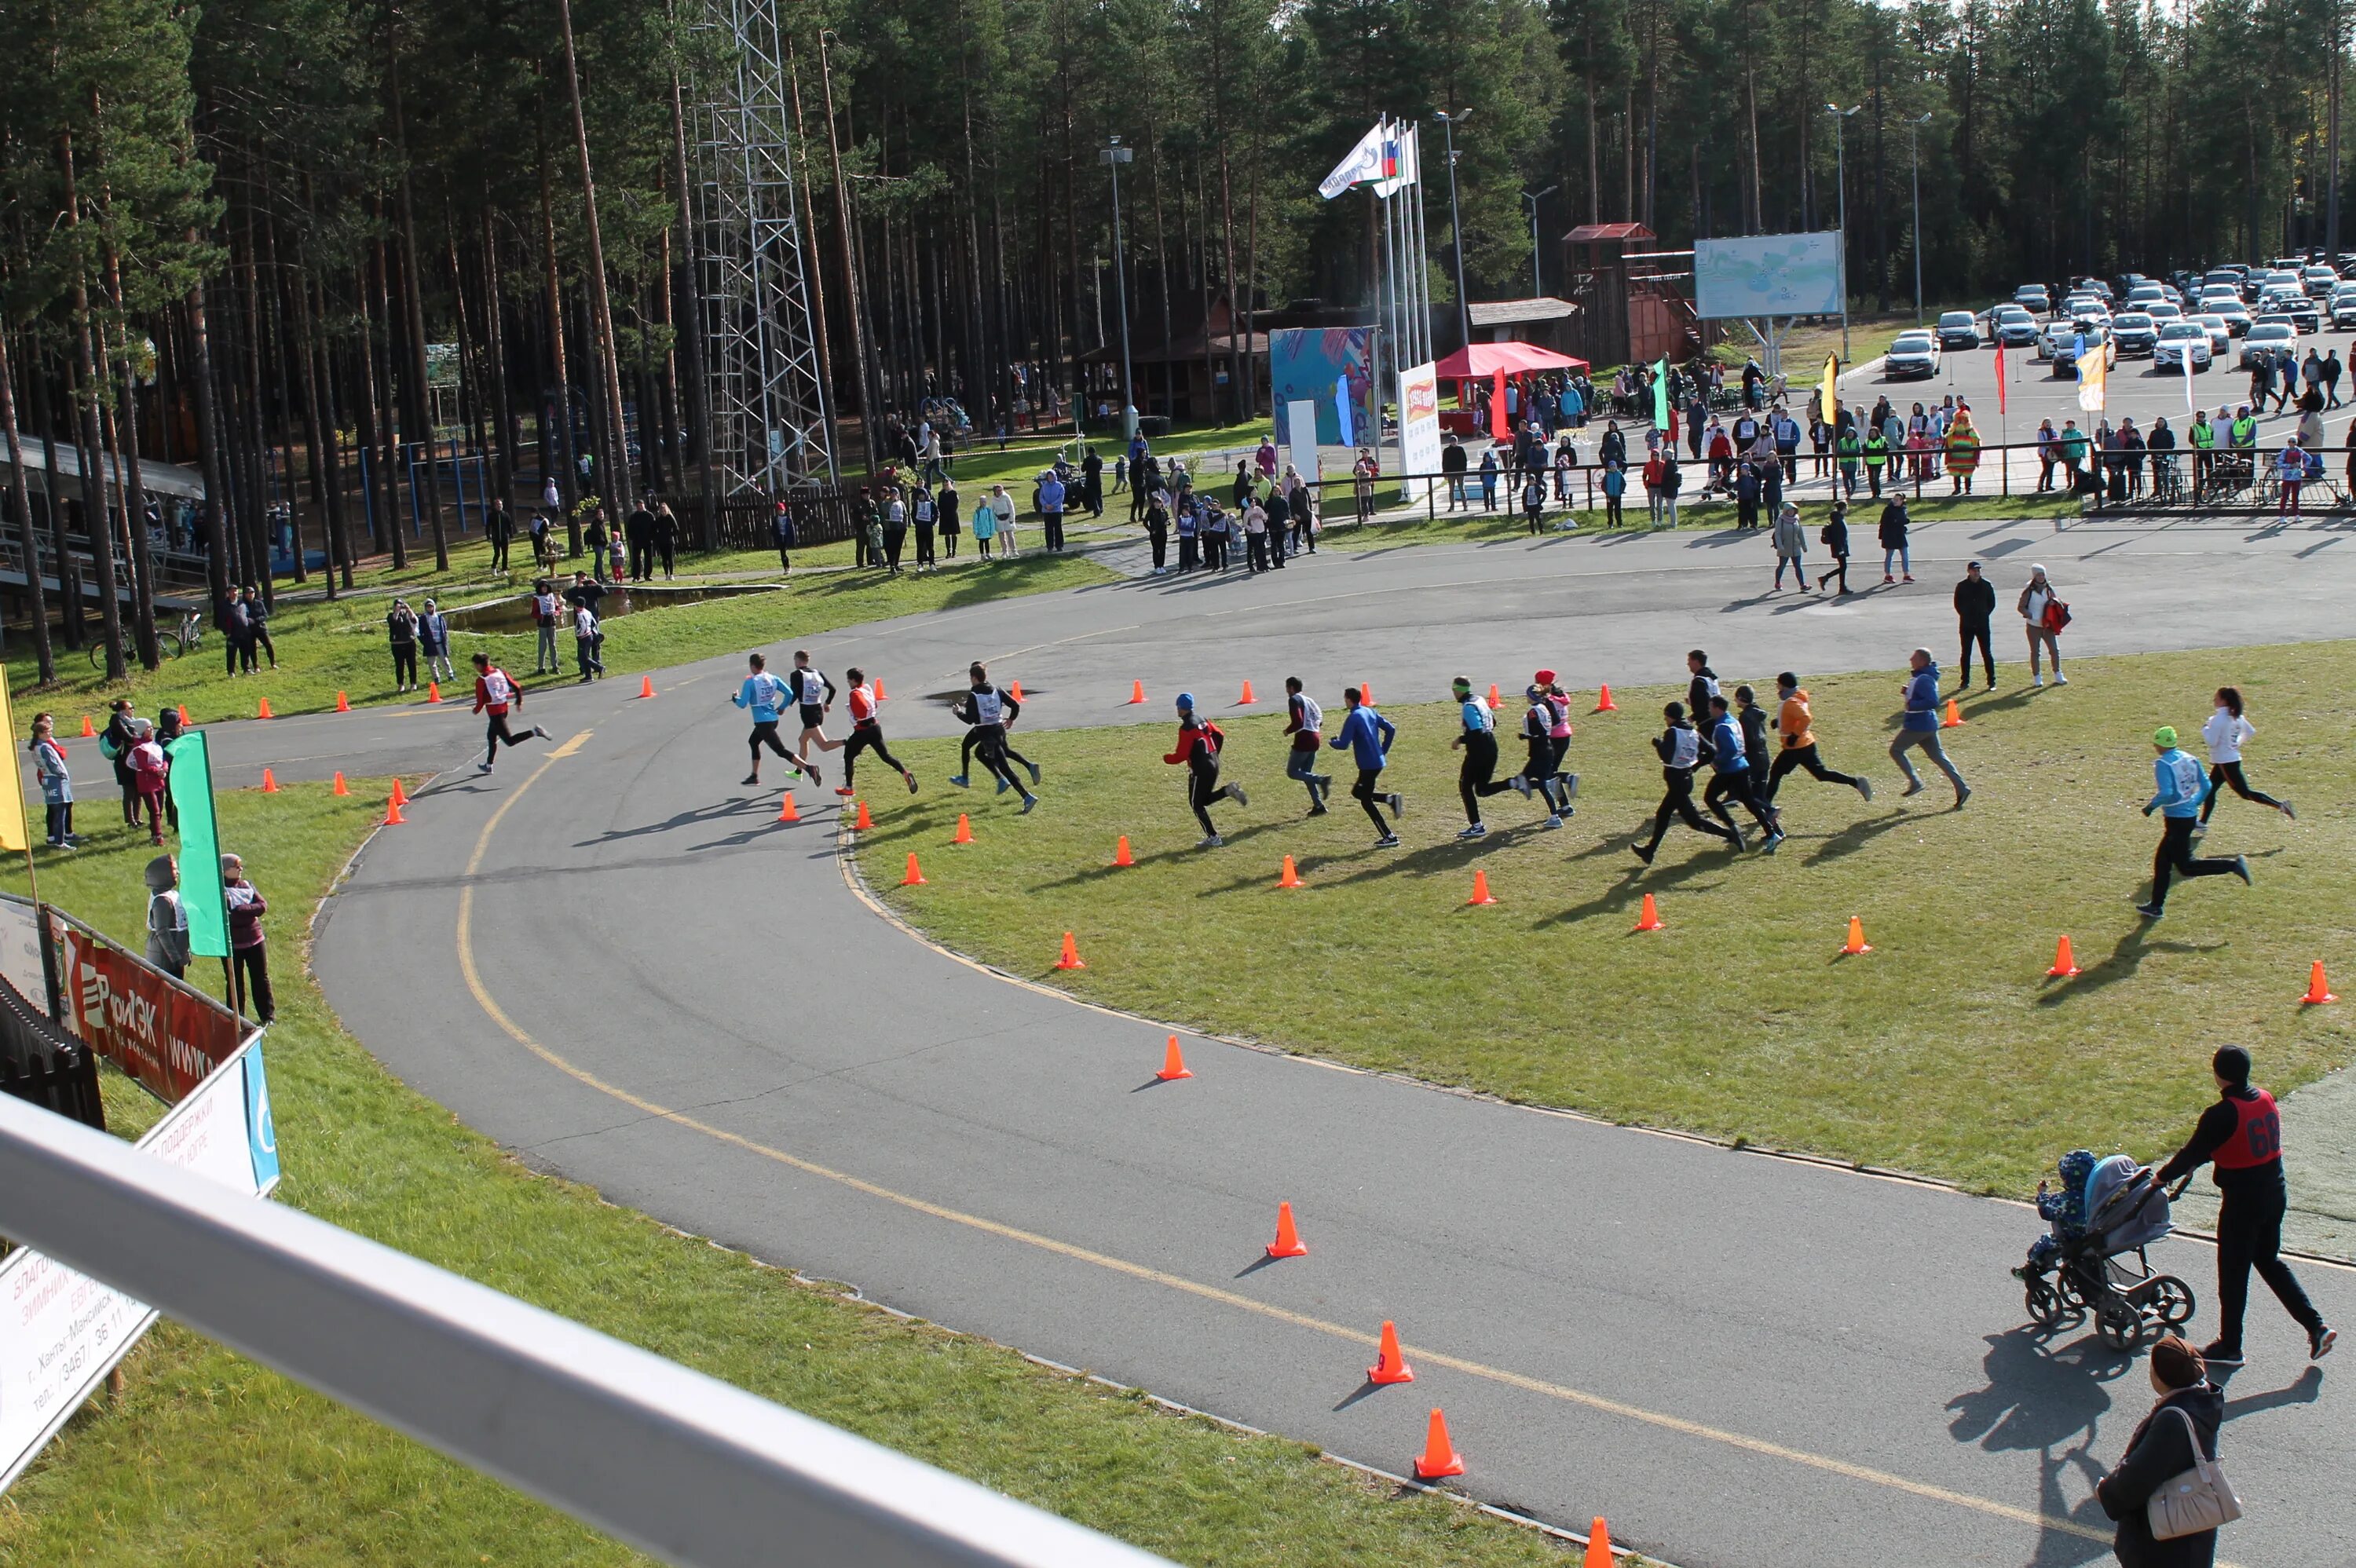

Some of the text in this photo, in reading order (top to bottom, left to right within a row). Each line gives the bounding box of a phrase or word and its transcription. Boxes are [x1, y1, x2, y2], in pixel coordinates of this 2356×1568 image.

[162, 1096, 213, 1158] ПОДДЕРЖКИ
[2247, 1112, 2280, 1158] 68
[22, 1268, 69, 1327] ЗИМНИХ
[95, 1322, 108, 1347] 36
[112, 1307, 123, 1329] 11
